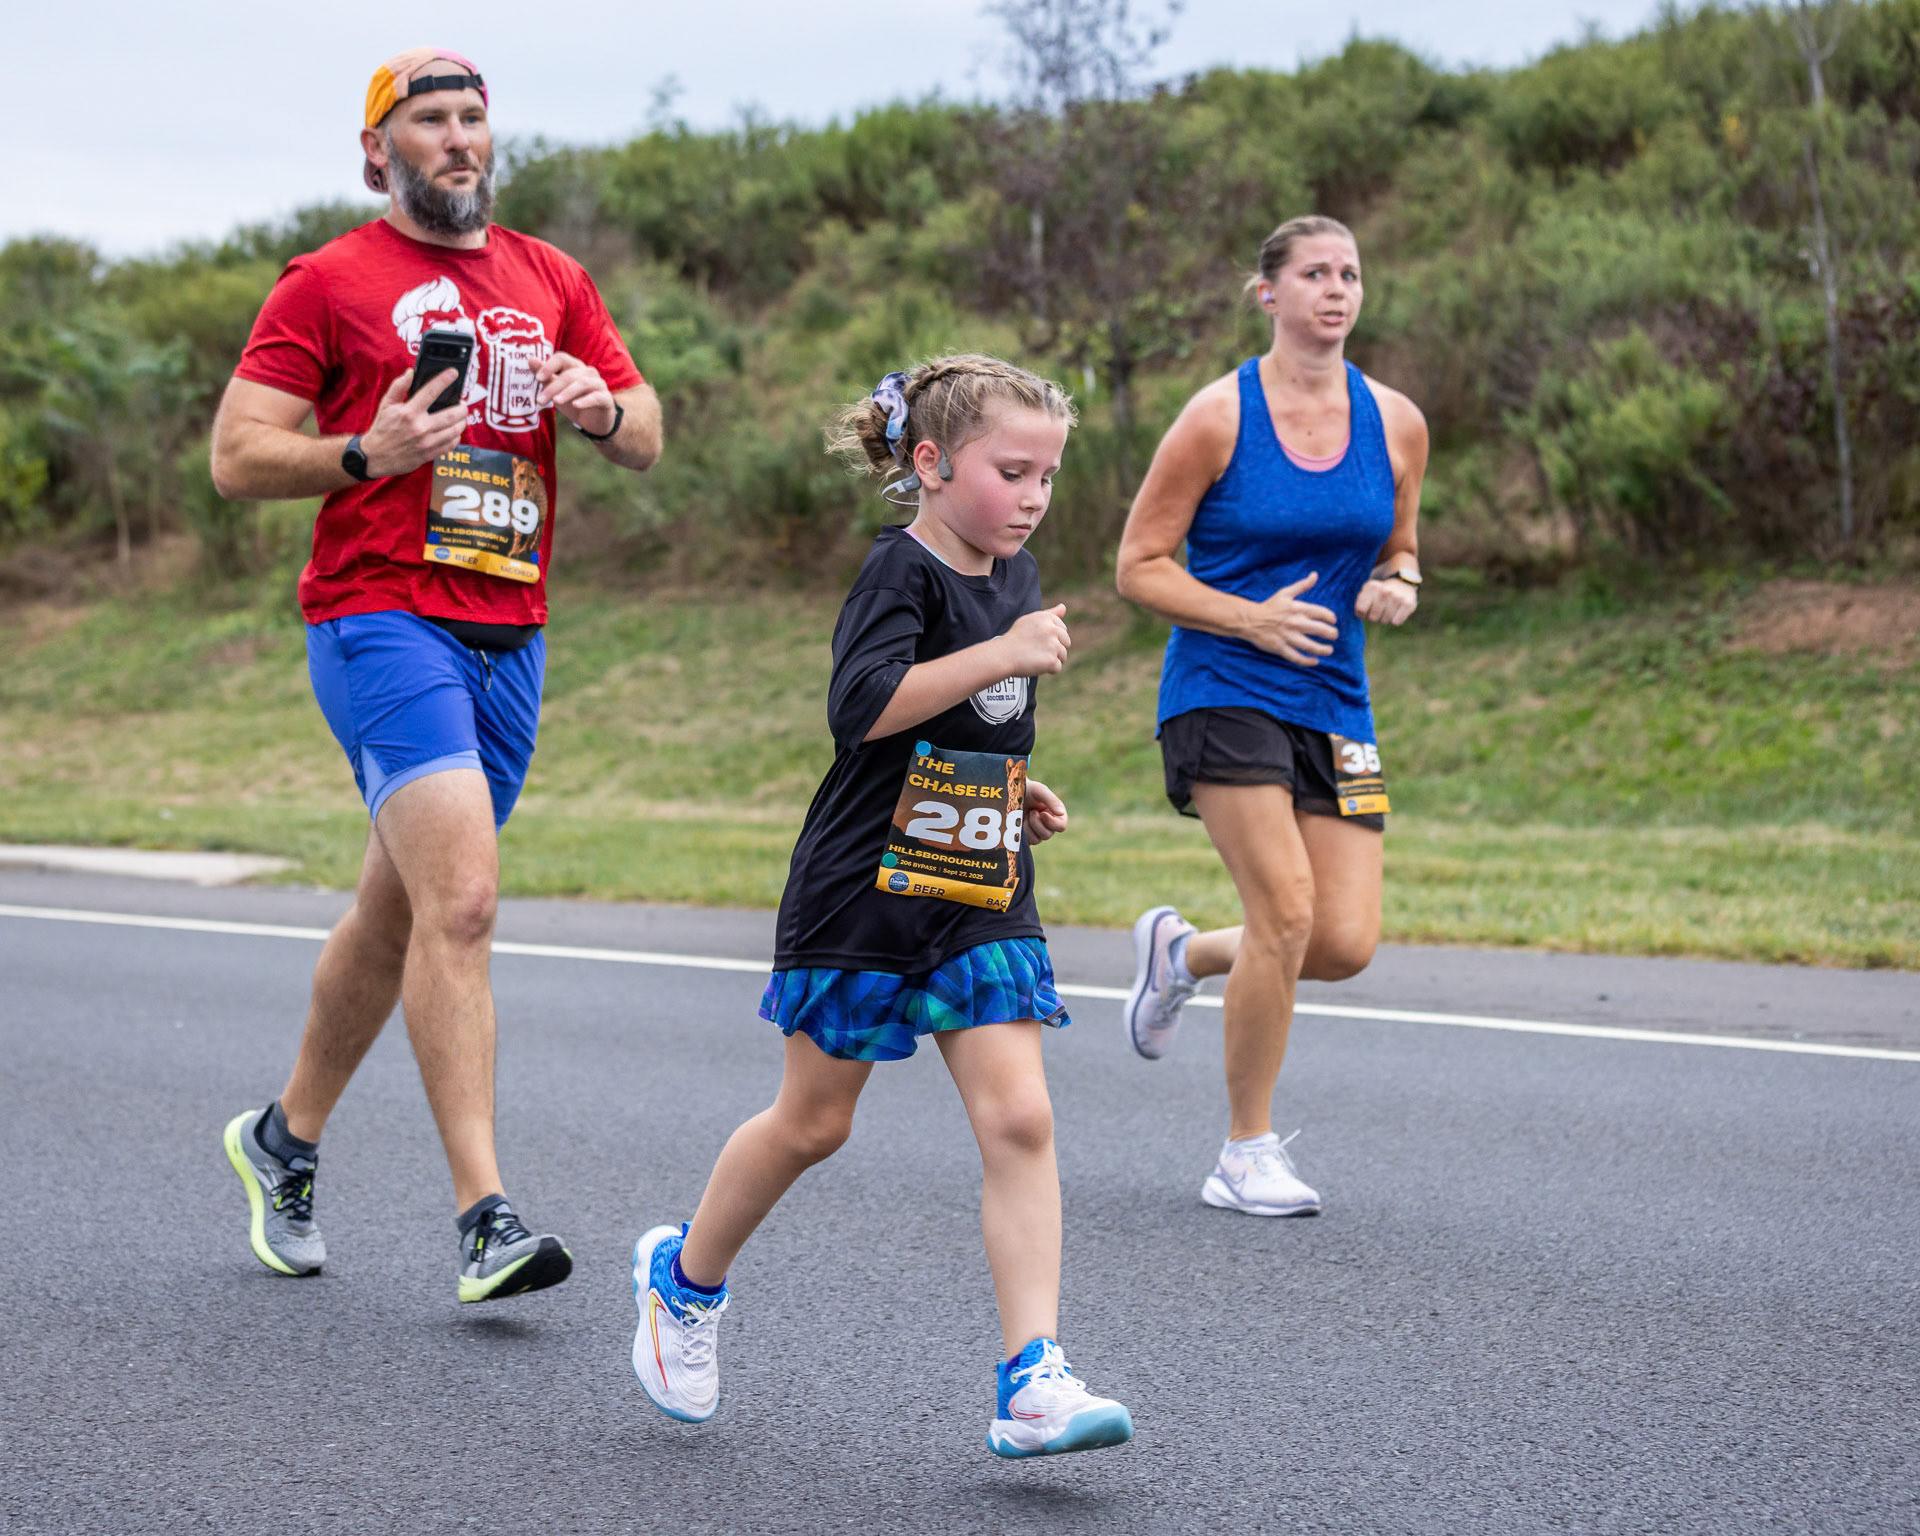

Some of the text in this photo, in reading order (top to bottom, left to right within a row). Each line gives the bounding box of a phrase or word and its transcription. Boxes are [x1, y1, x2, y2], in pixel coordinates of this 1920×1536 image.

[512, 396, 532, 408] IPA
[436, 466, 511, 488] CHASE 5K
[441, 484, 539, 534] 289
[455, 554, 479, 565] BEER
[916, 755, 956, 775] THE
[908, 773, 1003, 799] CHASE 5K
[905, 800, 1024, 852] 288
[900, 859, 912, 867] 206
[912, 862, 937, 872] BYPASS
[943, 868, 958, 877] Sept
[982, 862, 998, 870] NJ
[913, 884, 945, 896] BEER
[986, 898, 1007, 908] BAG
